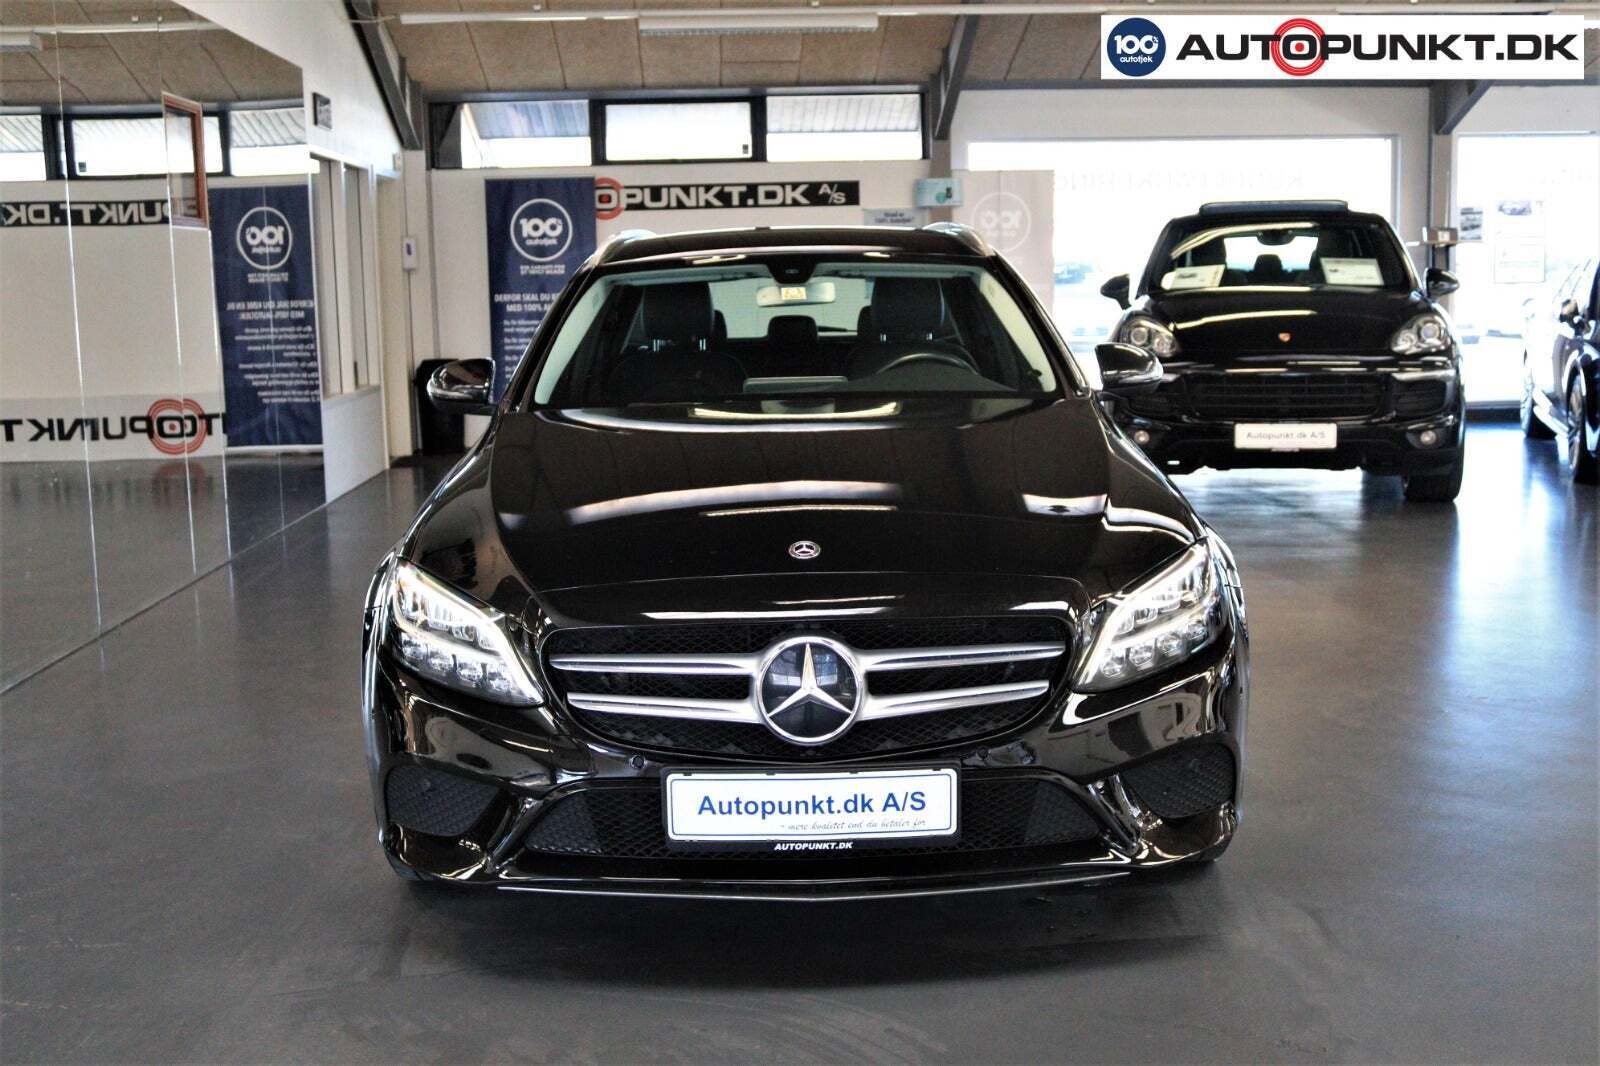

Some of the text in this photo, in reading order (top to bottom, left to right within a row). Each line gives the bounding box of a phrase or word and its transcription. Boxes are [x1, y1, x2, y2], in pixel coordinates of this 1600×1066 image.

[818, 183, 847, 205] A/S
[698, 791, 926, 820] Autopunkt.dk A/S
[787, 822, 809, 831] mere
[848, 820, 863, 829] end
[866, 820, 877, 828] du
[912, 819, 926, 829] for
[774, 841, 853, 851] AUTOPUNKT.DK
